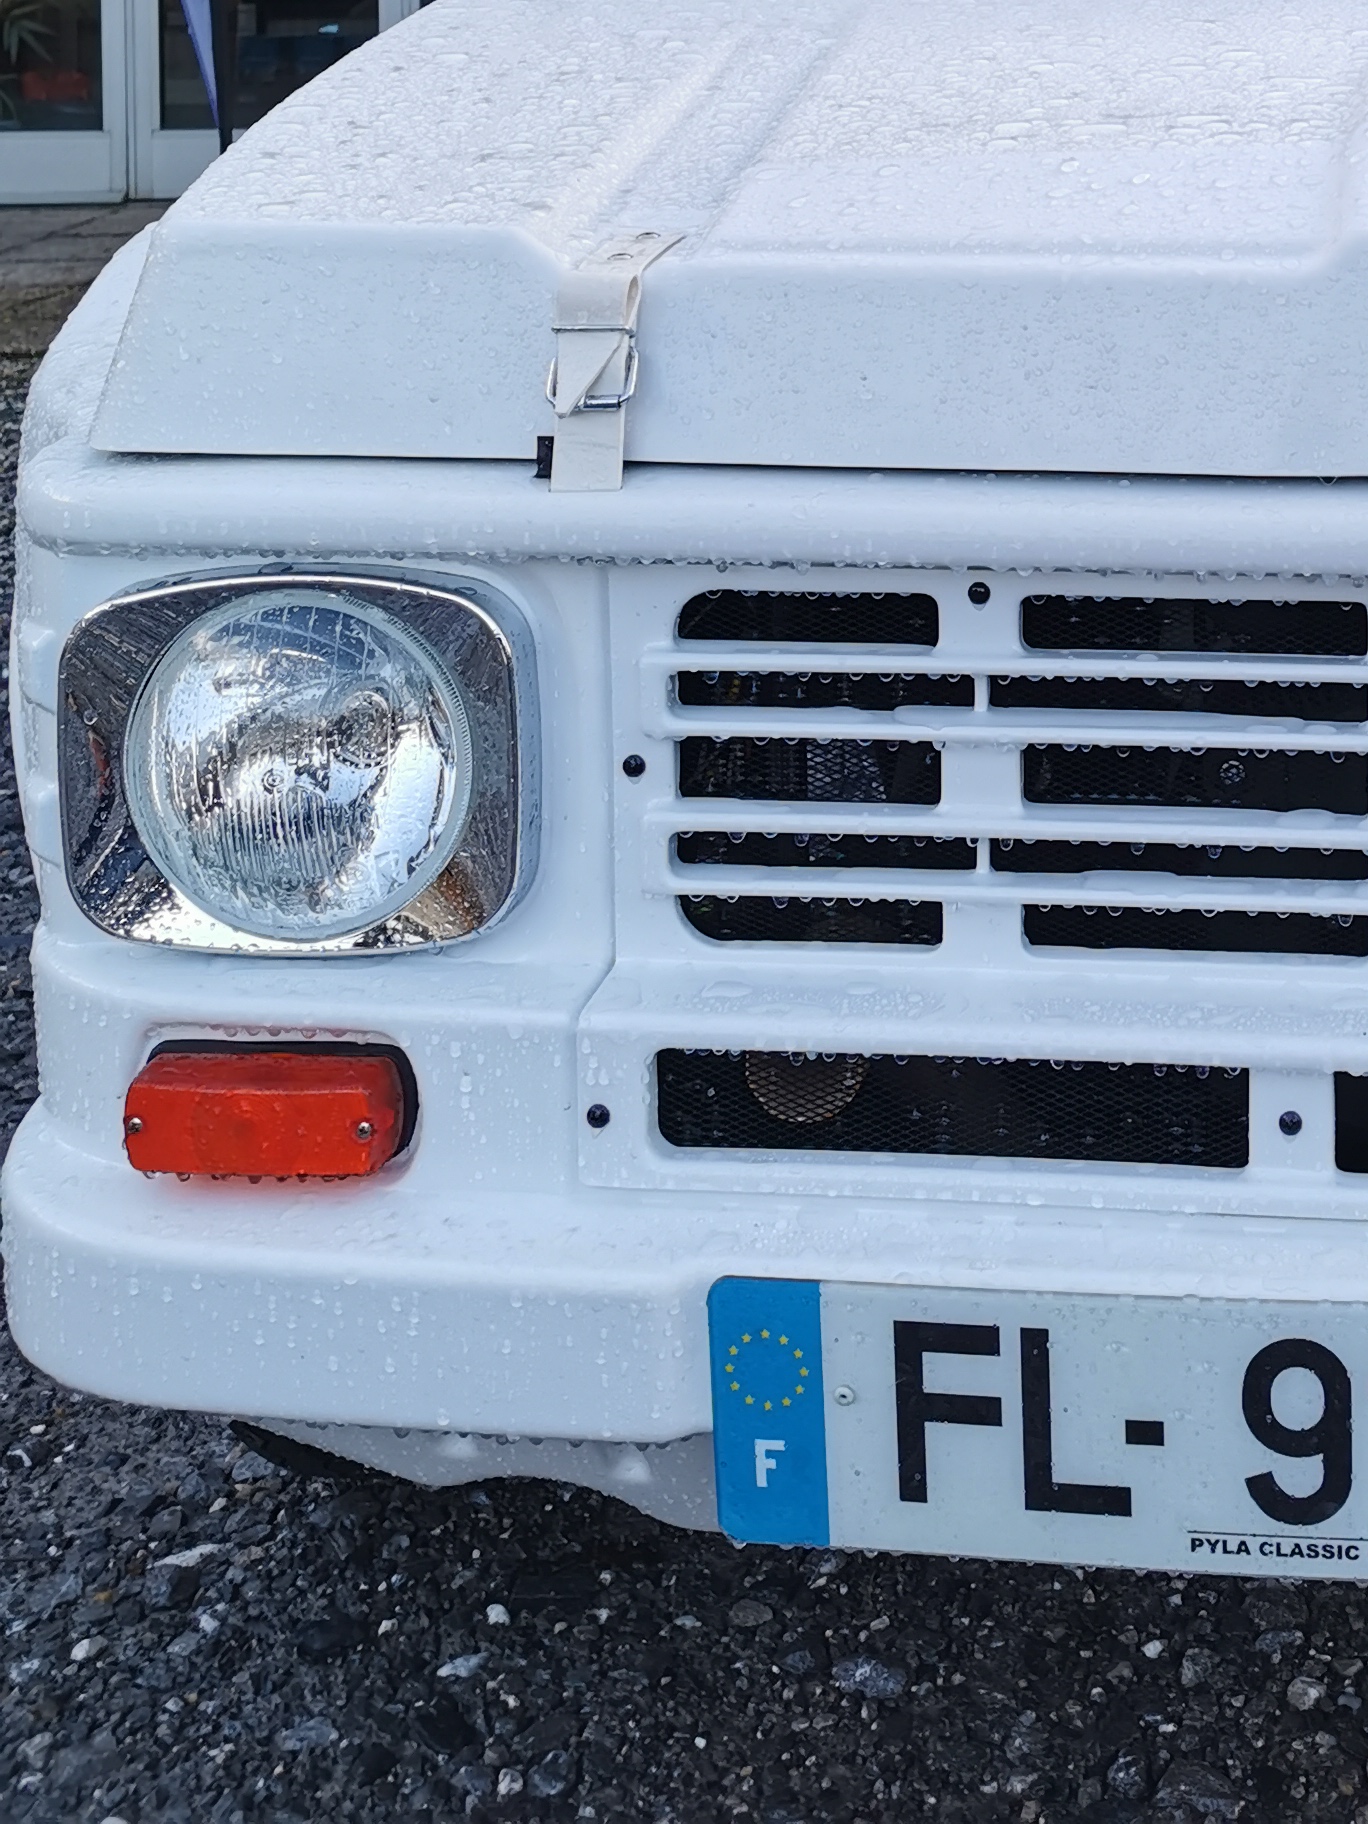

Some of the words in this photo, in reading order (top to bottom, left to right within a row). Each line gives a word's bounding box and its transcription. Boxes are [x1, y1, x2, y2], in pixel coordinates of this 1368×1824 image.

[754, 1438, 787, 1488] F
[1190, 1537, 1251, 1557] PYLA
[1259, 1541, 1361, 1562] CLASSIC
